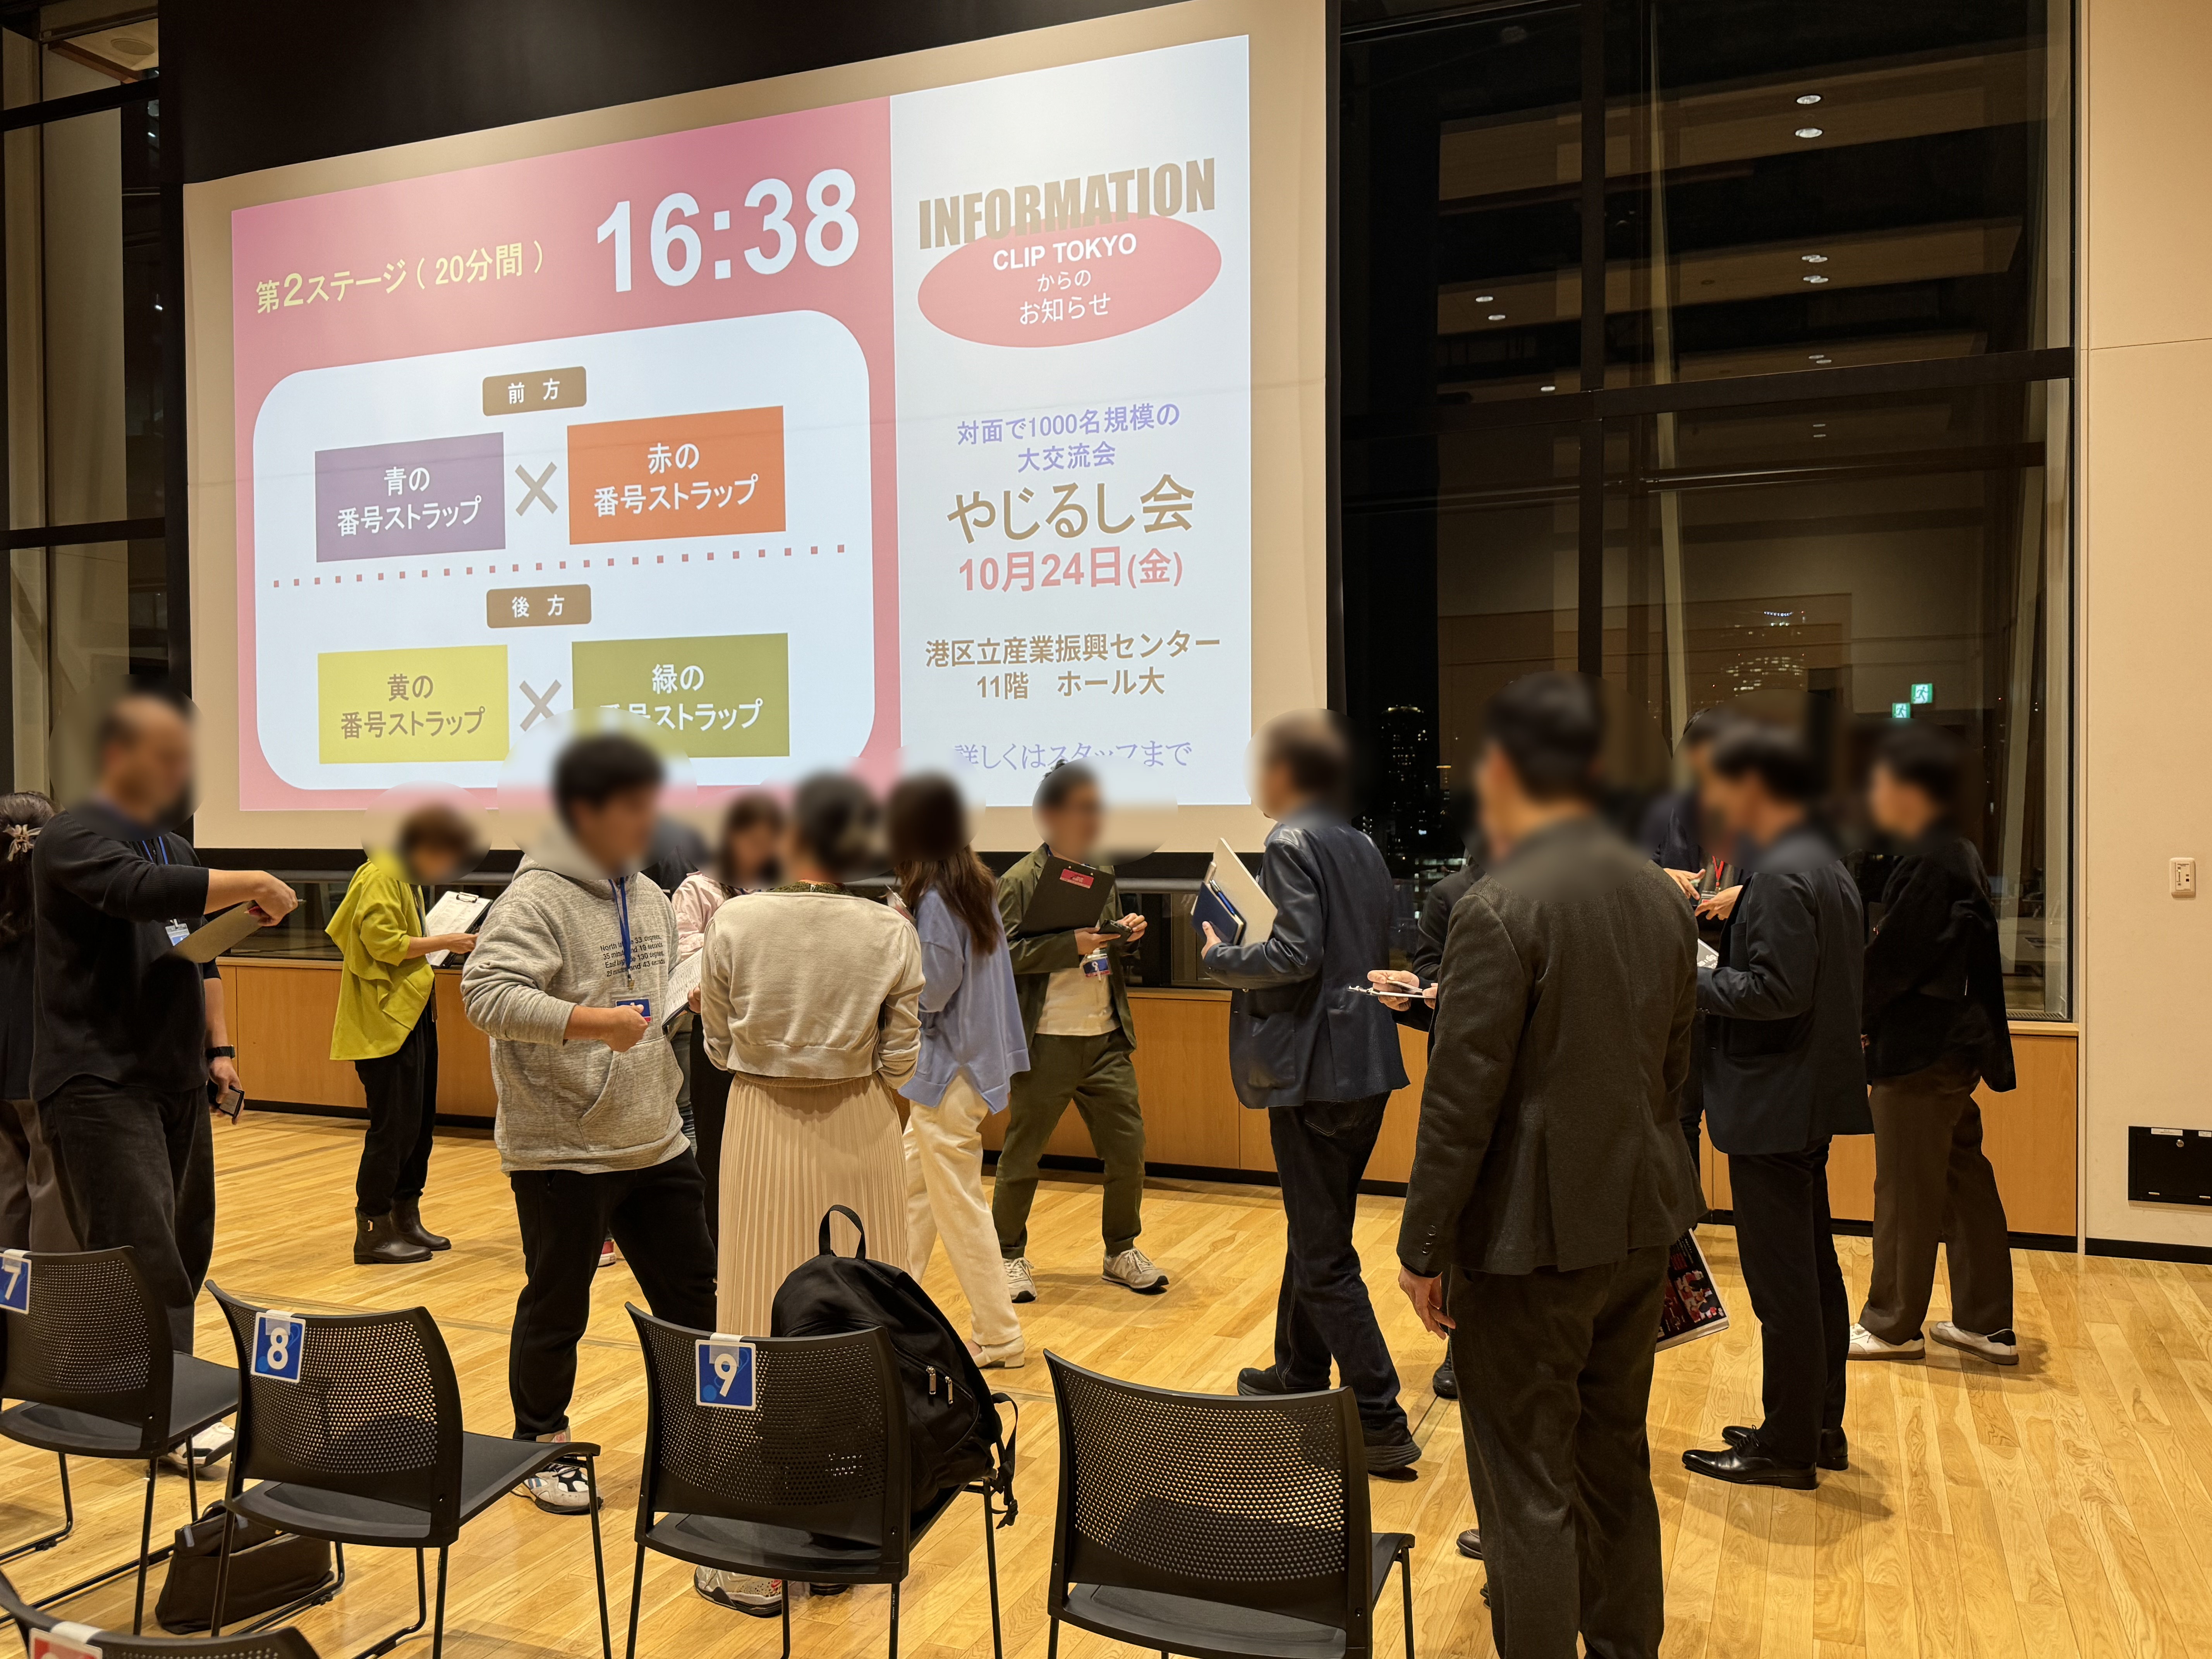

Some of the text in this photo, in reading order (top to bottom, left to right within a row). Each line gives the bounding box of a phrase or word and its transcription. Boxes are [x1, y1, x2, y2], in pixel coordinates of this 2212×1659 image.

[919, 158, 1215, 250] INFORMATION
[597, 168, 859, 293] 16:38
[993, 233, 1137, 270] CLIP TOKYO
[1037, 270, 1092, 292] からの
[1019, 293, 1111, 325] お知らせ
[957, 403, 1180, 445] 対面で1000名規模の
[647, 442, 700, 475] 赤の
[1018, 441, 1116, 472] 大交流会
[384, 466, 431, 496] 青の
[593, 473, 759, 518] 番号ストラップ
[337, 495, 483, 538] 番号ストラップ
[947, 474, 1195, 544] やじるし会
[959, 546, 1183, 592] 10月24日(金)
[925, 630, 1220, 668] 港区立産業振興センター
[387, 673, 434, 702] 黄の
[652, 663, 704, 694] 緑の
[977, 666, 1165, 700] 11階 ホール大
[341, 706, 486, 739] 番号ストラップ
[600, 698, 763, 731] ストラップ
[267, 1327, 288, 1370] 8
[714, 1353, 737, 1397] 9
